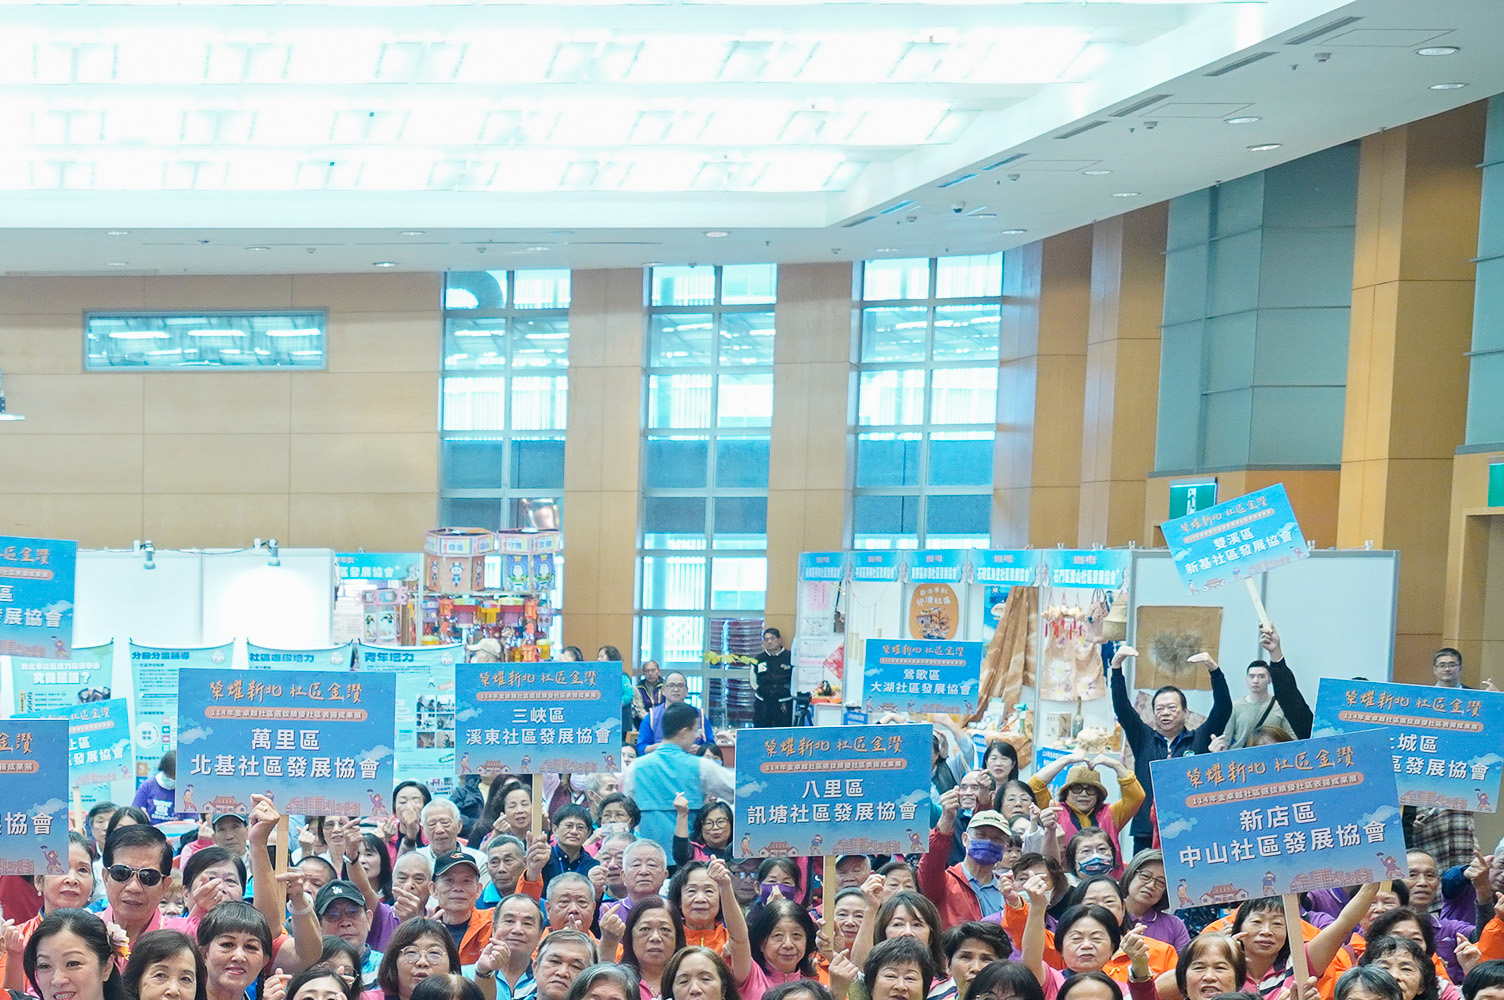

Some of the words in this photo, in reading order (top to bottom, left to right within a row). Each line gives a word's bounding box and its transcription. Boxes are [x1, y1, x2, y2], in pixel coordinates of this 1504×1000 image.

[1212, 527, 1254, 549] 雙溪區
[1185, 530, 1293, 575] 新基社區發展協會
[209, 680, 283, 702] 榮耀新北
[290, 681, 363, 704] 社區金讚
[870, 681, 973, 695] 大湖社區發展協會
[512, 707, 565, 724] 三峽區
[1346, 690, 1409, 709] 榮耀新北
[1416, 697, 1482, 718] 社區金讚
[251, 728, 320, 751] 萬里區
[466, 727, 611, 745] 溪東社區發展協會
[765, 737, 830, 757] 榮耀新北
[837, 735, 903, 754] 社區金讚
[1390, 732, 1439, 754] 城區
[69, 747, 123, 767] 發展協會
[190, 754, 380, 780] 北基社區發展協會
[1186, 758, 1267, 789] 榮耀新北
[1274, 747, 1356, 774] 社區金讚
[801, 779, 864, 799] 八里區
[747, 801, 918, 825] 訊塘社區發展協會
[1239, 801, 1317, 832] 新店區
[1179, 821, 1386, 869] 中山社區發展協會
